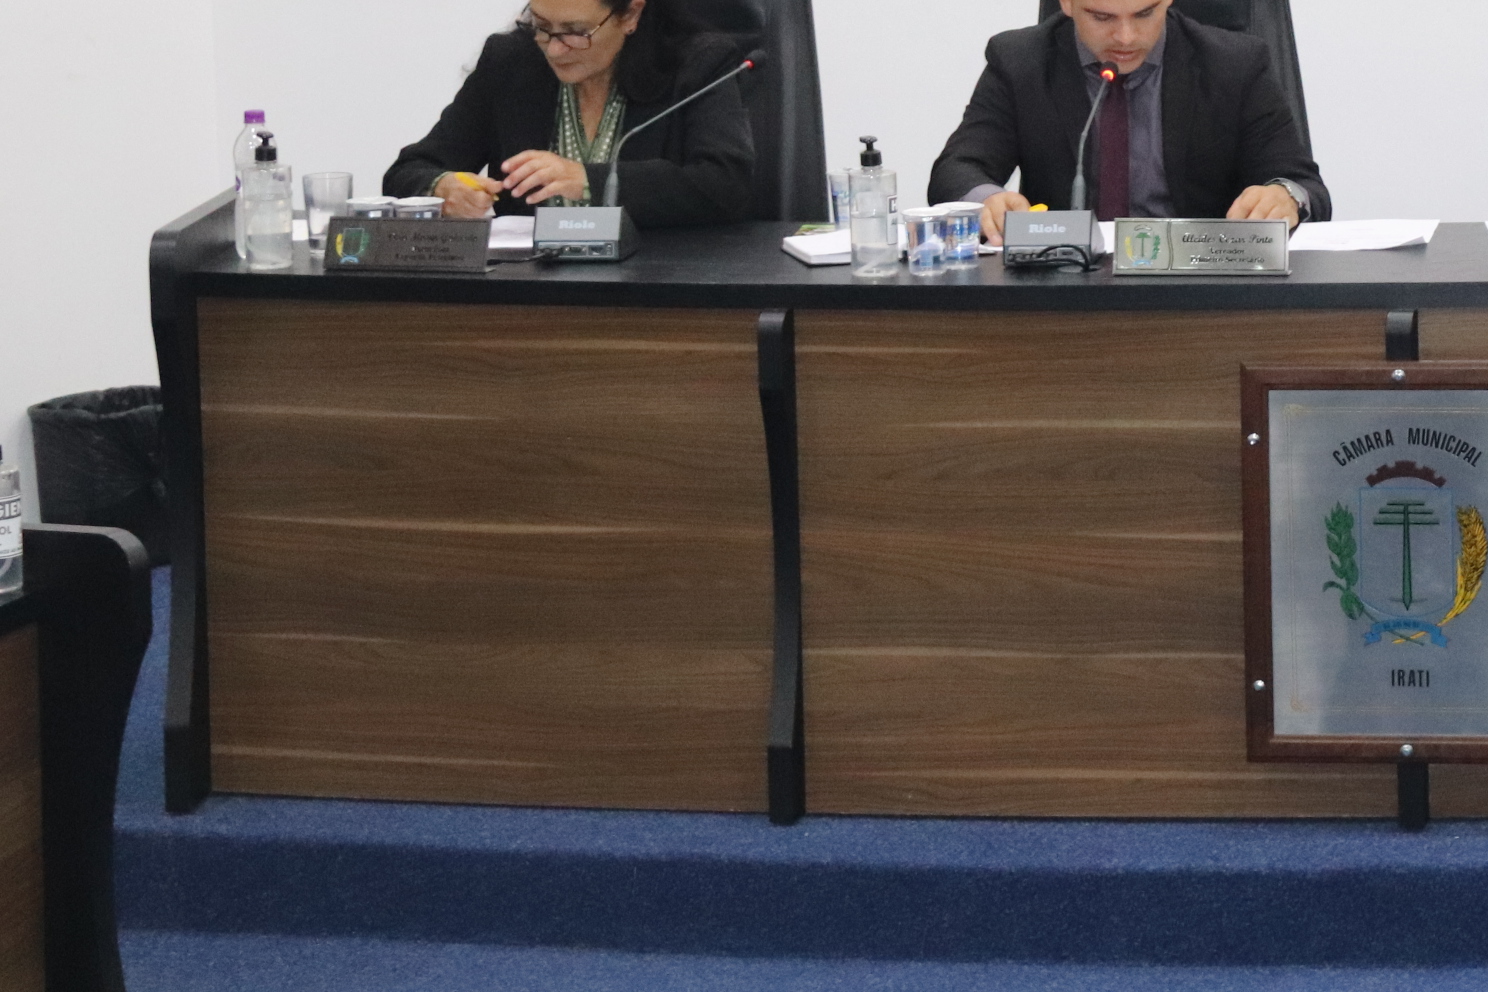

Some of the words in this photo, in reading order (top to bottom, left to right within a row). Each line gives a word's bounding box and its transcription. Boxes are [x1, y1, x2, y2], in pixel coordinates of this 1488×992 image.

[559, 220, 595, 229] Riole
[1029, 224, 1066, 233] Riole
[1333, 429, 1395, 467] CÂMARA
[1407, 427, 1483, 468] MUNICIPAL
[1391, 669, 1430, 687] IRATI
